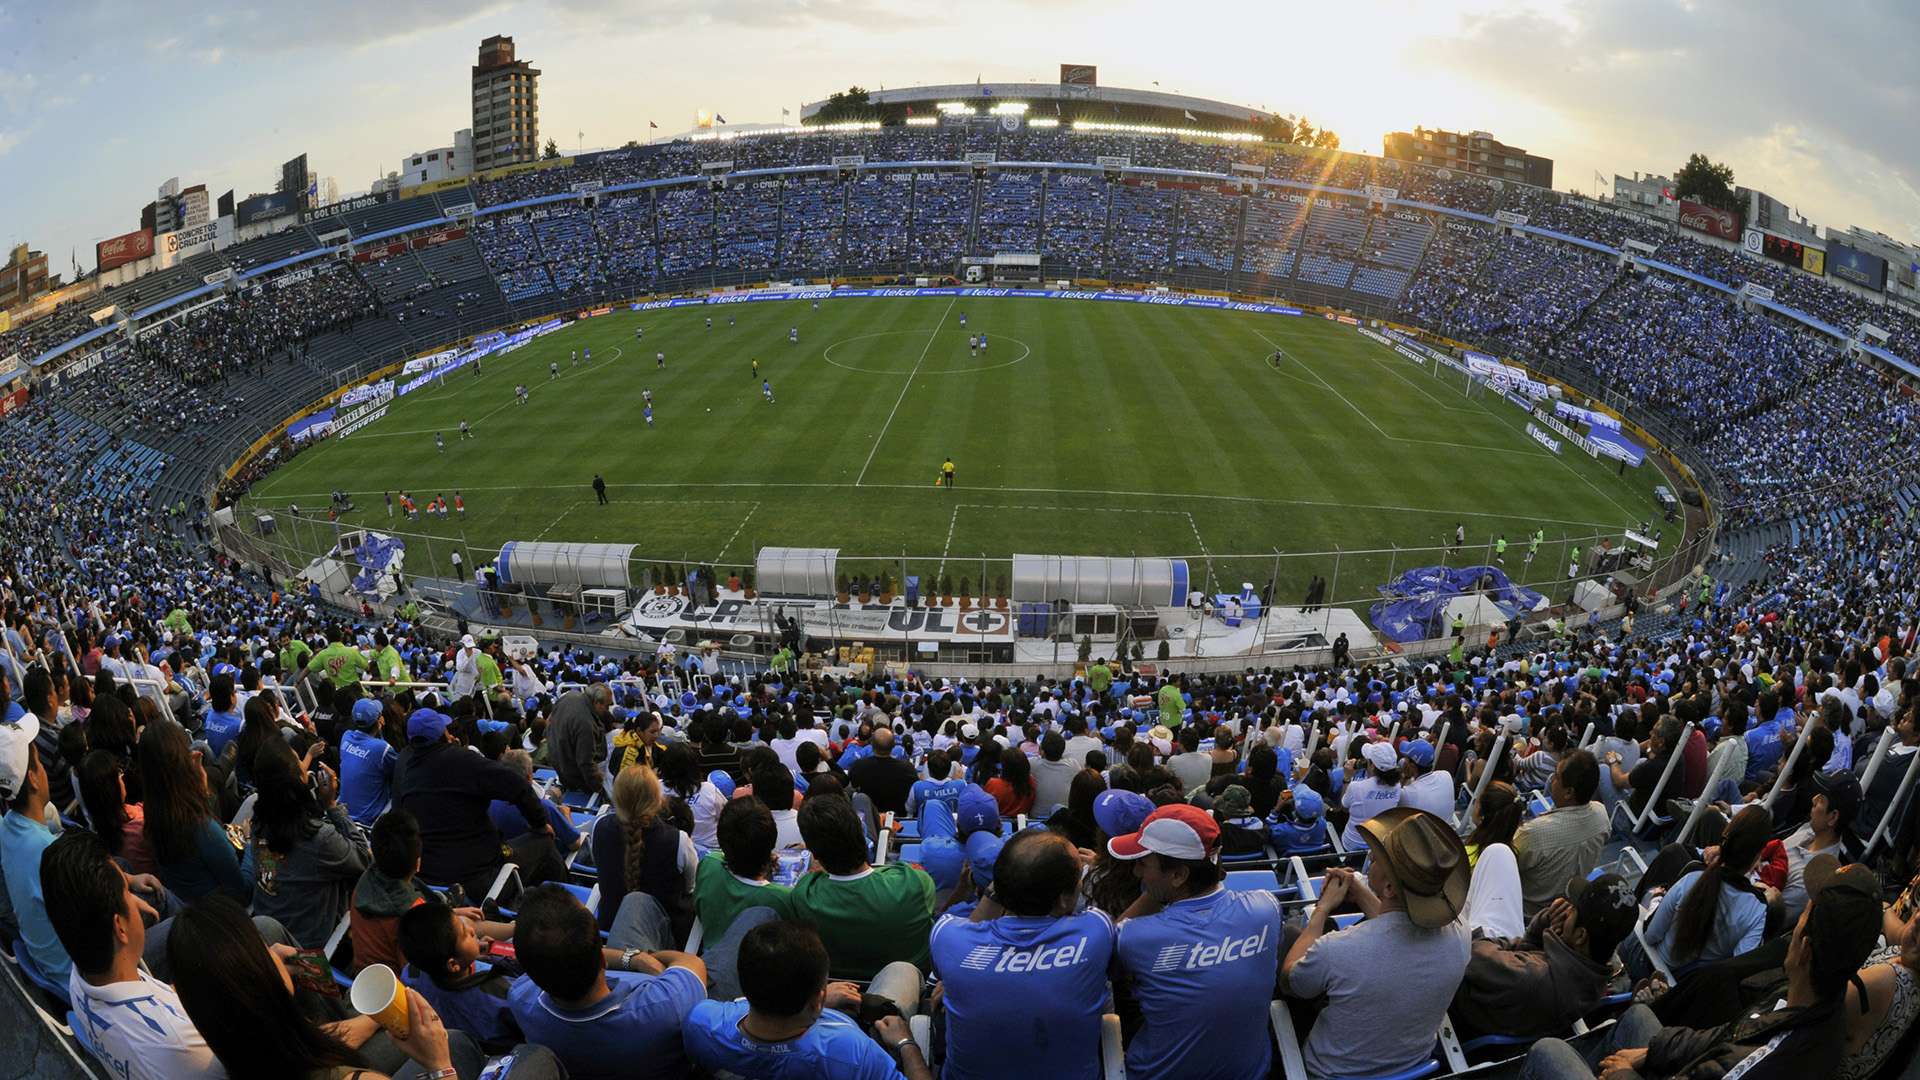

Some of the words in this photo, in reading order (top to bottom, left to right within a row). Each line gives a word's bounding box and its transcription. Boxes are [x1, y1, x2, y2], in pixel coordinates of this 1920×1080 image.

[314, 208, 329, 220] GOL
[331, 205, 340, 215] ES
[341, 203, 351, 214] DE
[1393, 212, 1422, 223] SONY
[179, 222, 218, 241] CONCRETOS
[1446, 222, 1474, 234] SONY
[179, 238, 198, 250] CRUZ
[198, 232, 218, 244] AZUL
[1651, 277, 1675, 292] telcel
[717, 294, 752, 304] telcel
[798, 290, 833, 300] telcel
[882, 288, 918, 297] telcel
[970, 288, 1009, 297] telcel
[1060, 290, 1100, 300] telcel
[642, 300, 674, 310] telcel
[1149, 294, 1185, 305] telcel
[1233, 302, 1270, 313] telcel
[140, 325, 164, 342] SONY
[466, 346, 490, 363] telcel
[408, 371, 434, 390] telcel
[1532, 425, 1559, 452] telcel
[347, 743, 368, 760] telcel
[934, 787, 958, 797] VILLA
[1186, 924, 1269, 970] telcel
[994, 936, 1082, 973] telcel
